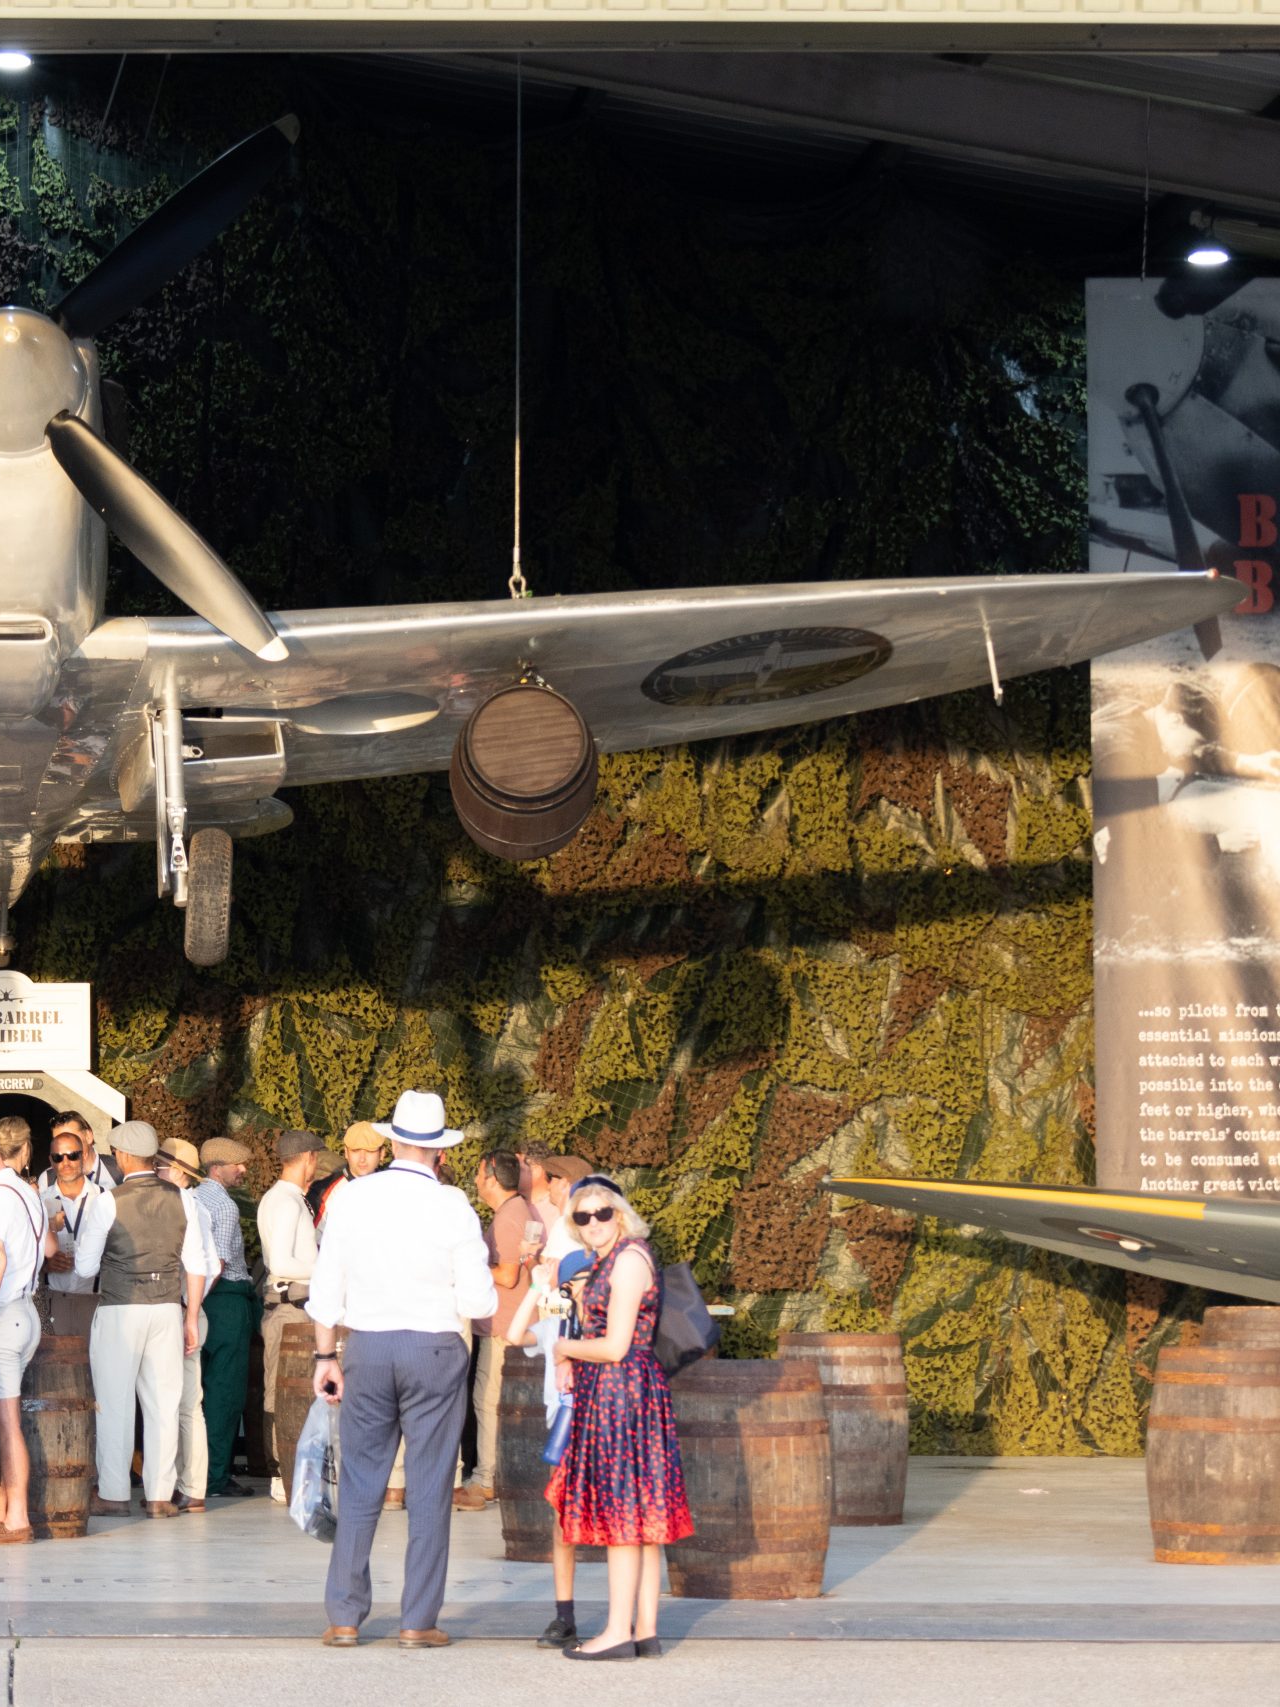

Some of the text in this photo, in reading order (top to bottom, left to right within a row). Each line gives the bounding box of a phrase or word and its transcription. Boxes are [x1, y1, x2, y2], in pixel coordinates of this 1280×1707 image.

[686, 628, 865, 658] SILVER SPITFIRE
[1178, 1003, 1228, 1020] pilots
[1235, 1003, 1268, 1018] from
[1138, 1028, 1211, 1042] essential
[1138, 1053, 1204, 1067] attached
[1209, 1053, 1226, 1067] to
[1231, 1053, 1264, 1067] each
[1138, 1078, 1204, 1095] possible
[1209, 1078, 1243, 1092] into
[1248, 1078, 1274, 1092] the
[1139, 1103, 1171, 1117] feet
[1175, 1105, 1193, 1117] or
[1197, 1103, 1254, 1120] higher,
[1139, 1128, 1165, 1142] the
[1140, 1153, 1157, 1167] to
[1165, 1153, 1183, 1167] be
[1191, 1152, 1260, 1167] consumed
[1140, 1177, 1200, 1192] Another
[1203, 1178, 1245, 1195] great
